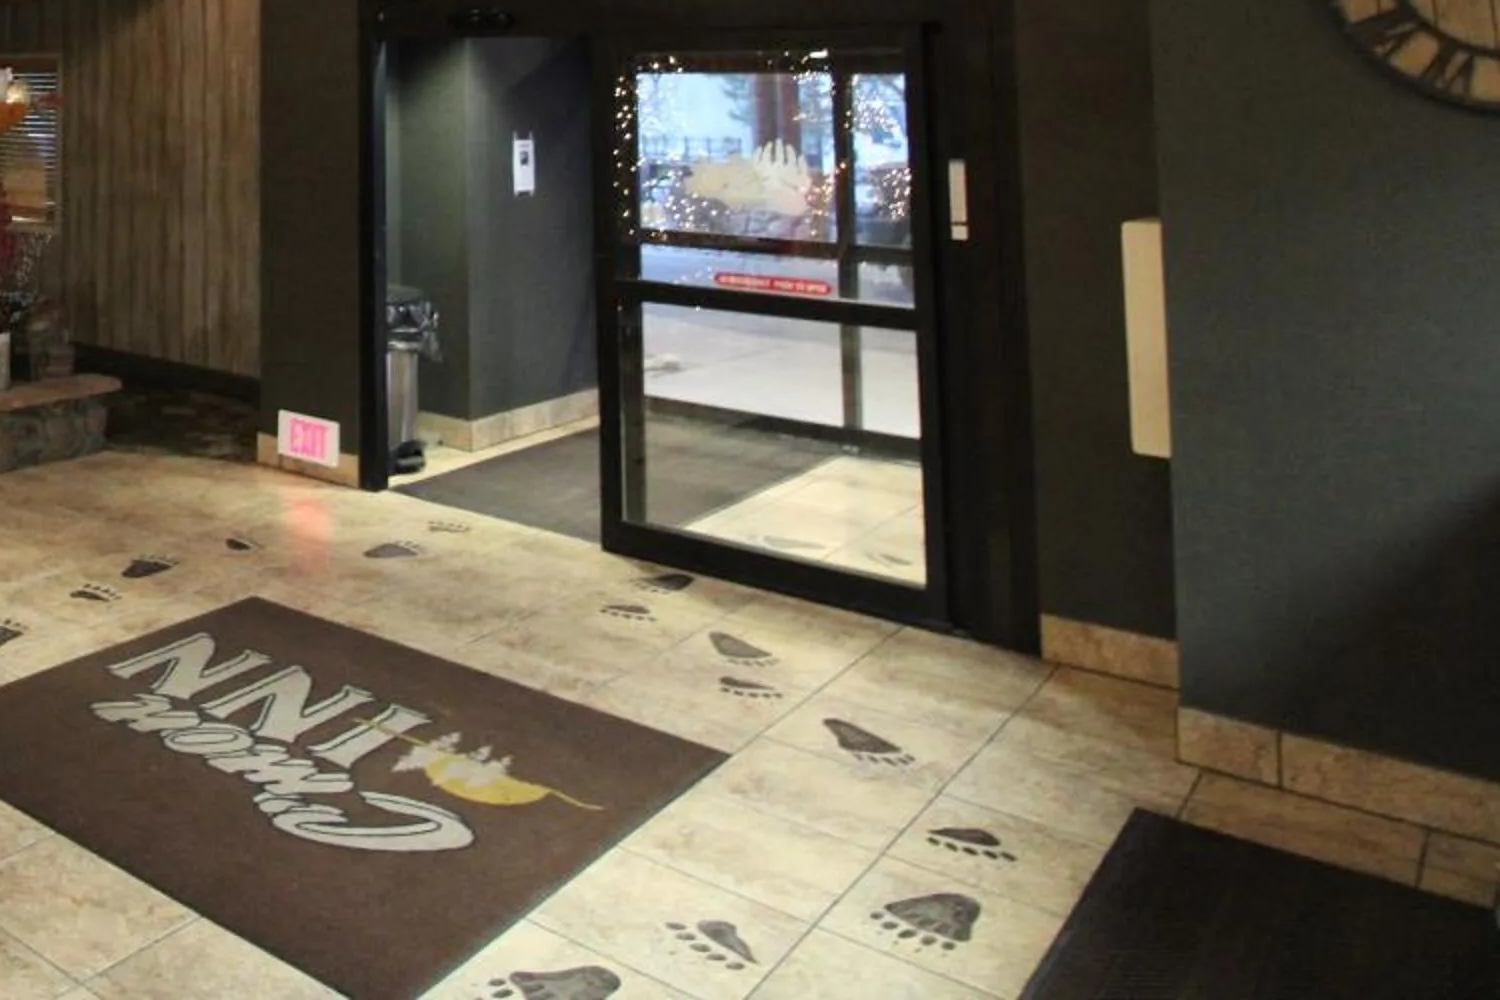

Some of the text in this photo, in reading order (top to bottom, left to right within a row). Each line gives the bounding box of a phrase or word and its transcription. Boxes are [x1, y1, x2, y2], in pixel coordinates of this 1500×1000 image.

[290, 417, 328, 460] EXIT
[108, 632, 433, 769] INN
[90, 693, 475, 852] C'mon
